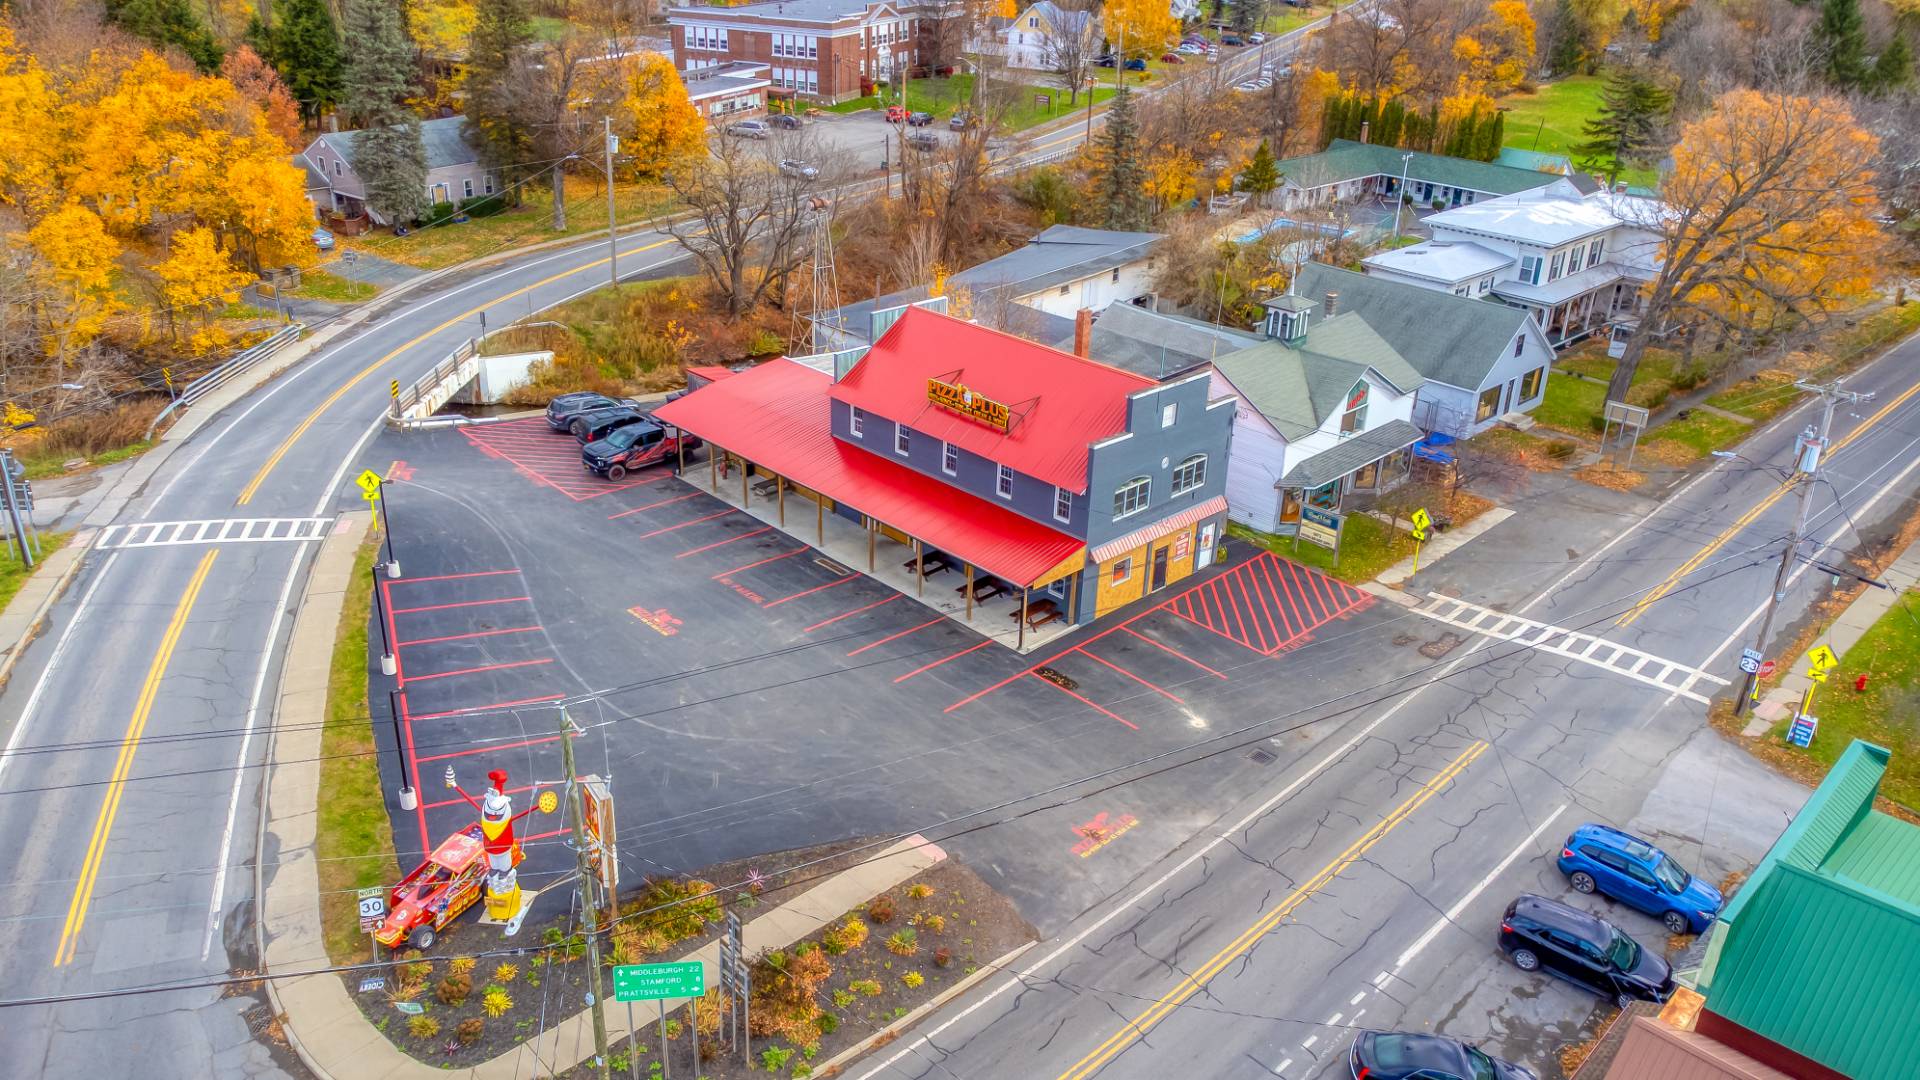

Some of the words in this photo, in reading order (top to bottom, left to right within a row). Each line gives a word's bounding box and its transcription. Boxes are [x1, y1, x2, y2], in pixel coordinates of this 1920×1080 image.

[928, 379, 966, 405] PIZZA
[972, 393, 1009, 421] PLUS
[1746, 649, 1760, 659] EAST
[1741, 659, 1757, 671] 23
[1757, 663, 1774, 674] STOP
[360, 887, 384, 897] NORTH
[361, 900, 382, 913] 30
[630, 966, 684, 977] MIDDLEBURGH
[688, 965, 700, 973] 22
[640, 977, 682, 986] STAMFORD
[618, 986, 670, 998] PRATTSVILLE
